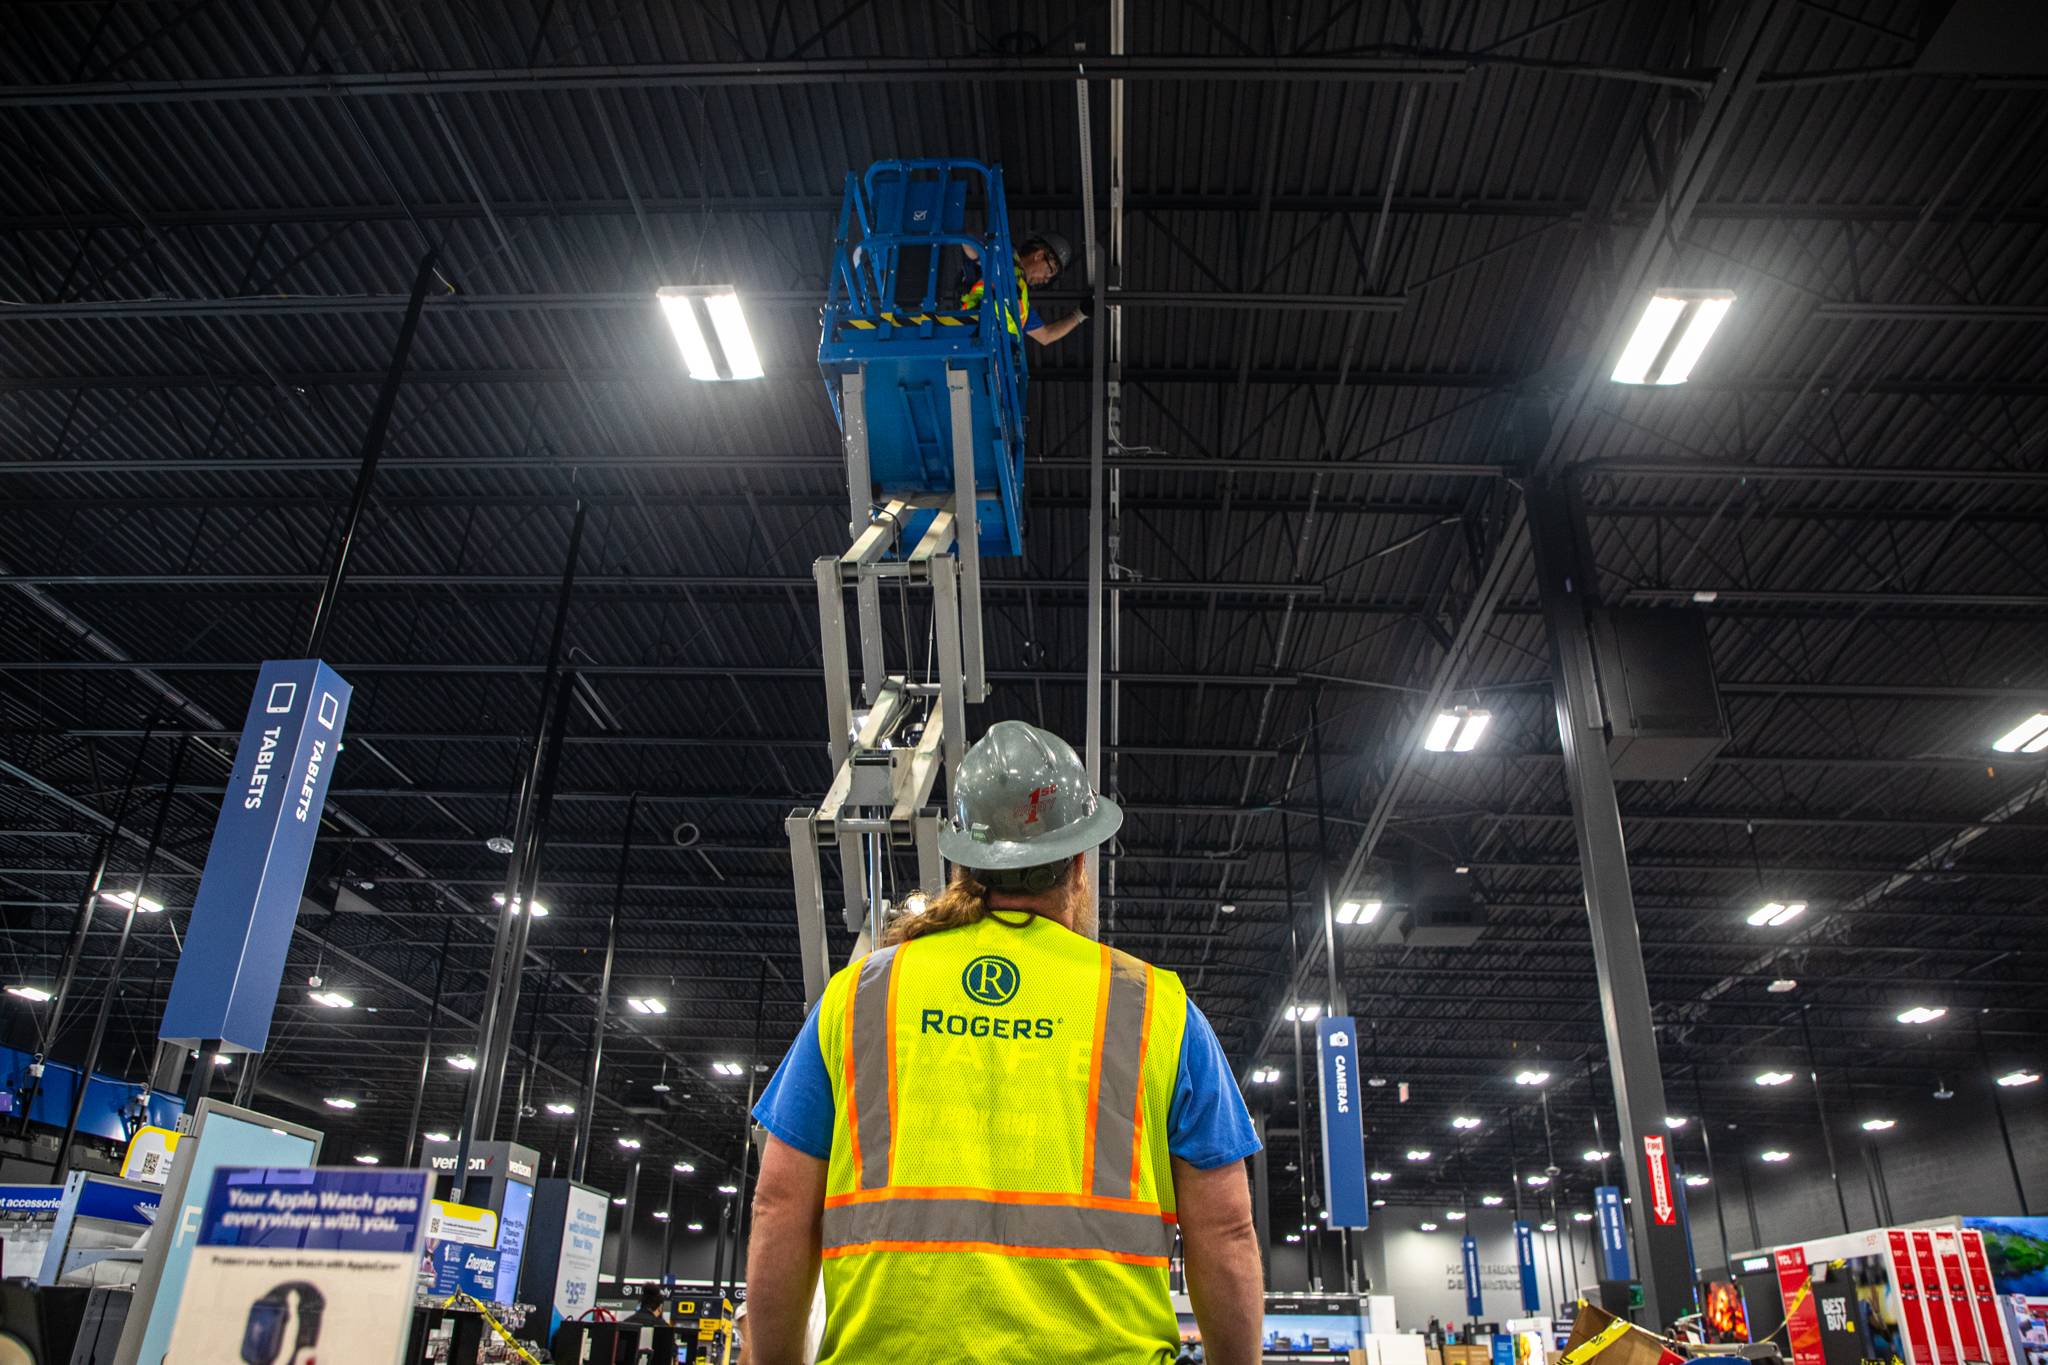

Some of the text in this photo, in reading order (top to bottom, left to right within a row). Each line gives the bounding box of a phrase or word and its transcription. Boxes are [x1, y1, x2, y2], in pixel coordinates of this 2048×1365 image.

[245, 726, 281, 809] TABLETS
[295, 739, 326, 823] TABLETS
[921, 1009, 1054, 1040] ROGERS
[1335, 1055, 1349, 1113] CAMERAS
[6, 1198, 64, 1209] accessorie
[228, 1188, 418, 1214] Your Apple Watch goes
[222, 1211, 399, 1234] everywhere with you.
[1778, 1255, 1792, 1265] TCL
[1822, 1297, 1846, 1315] BEST
[1826, 1314, 1847, 1331] BUY
